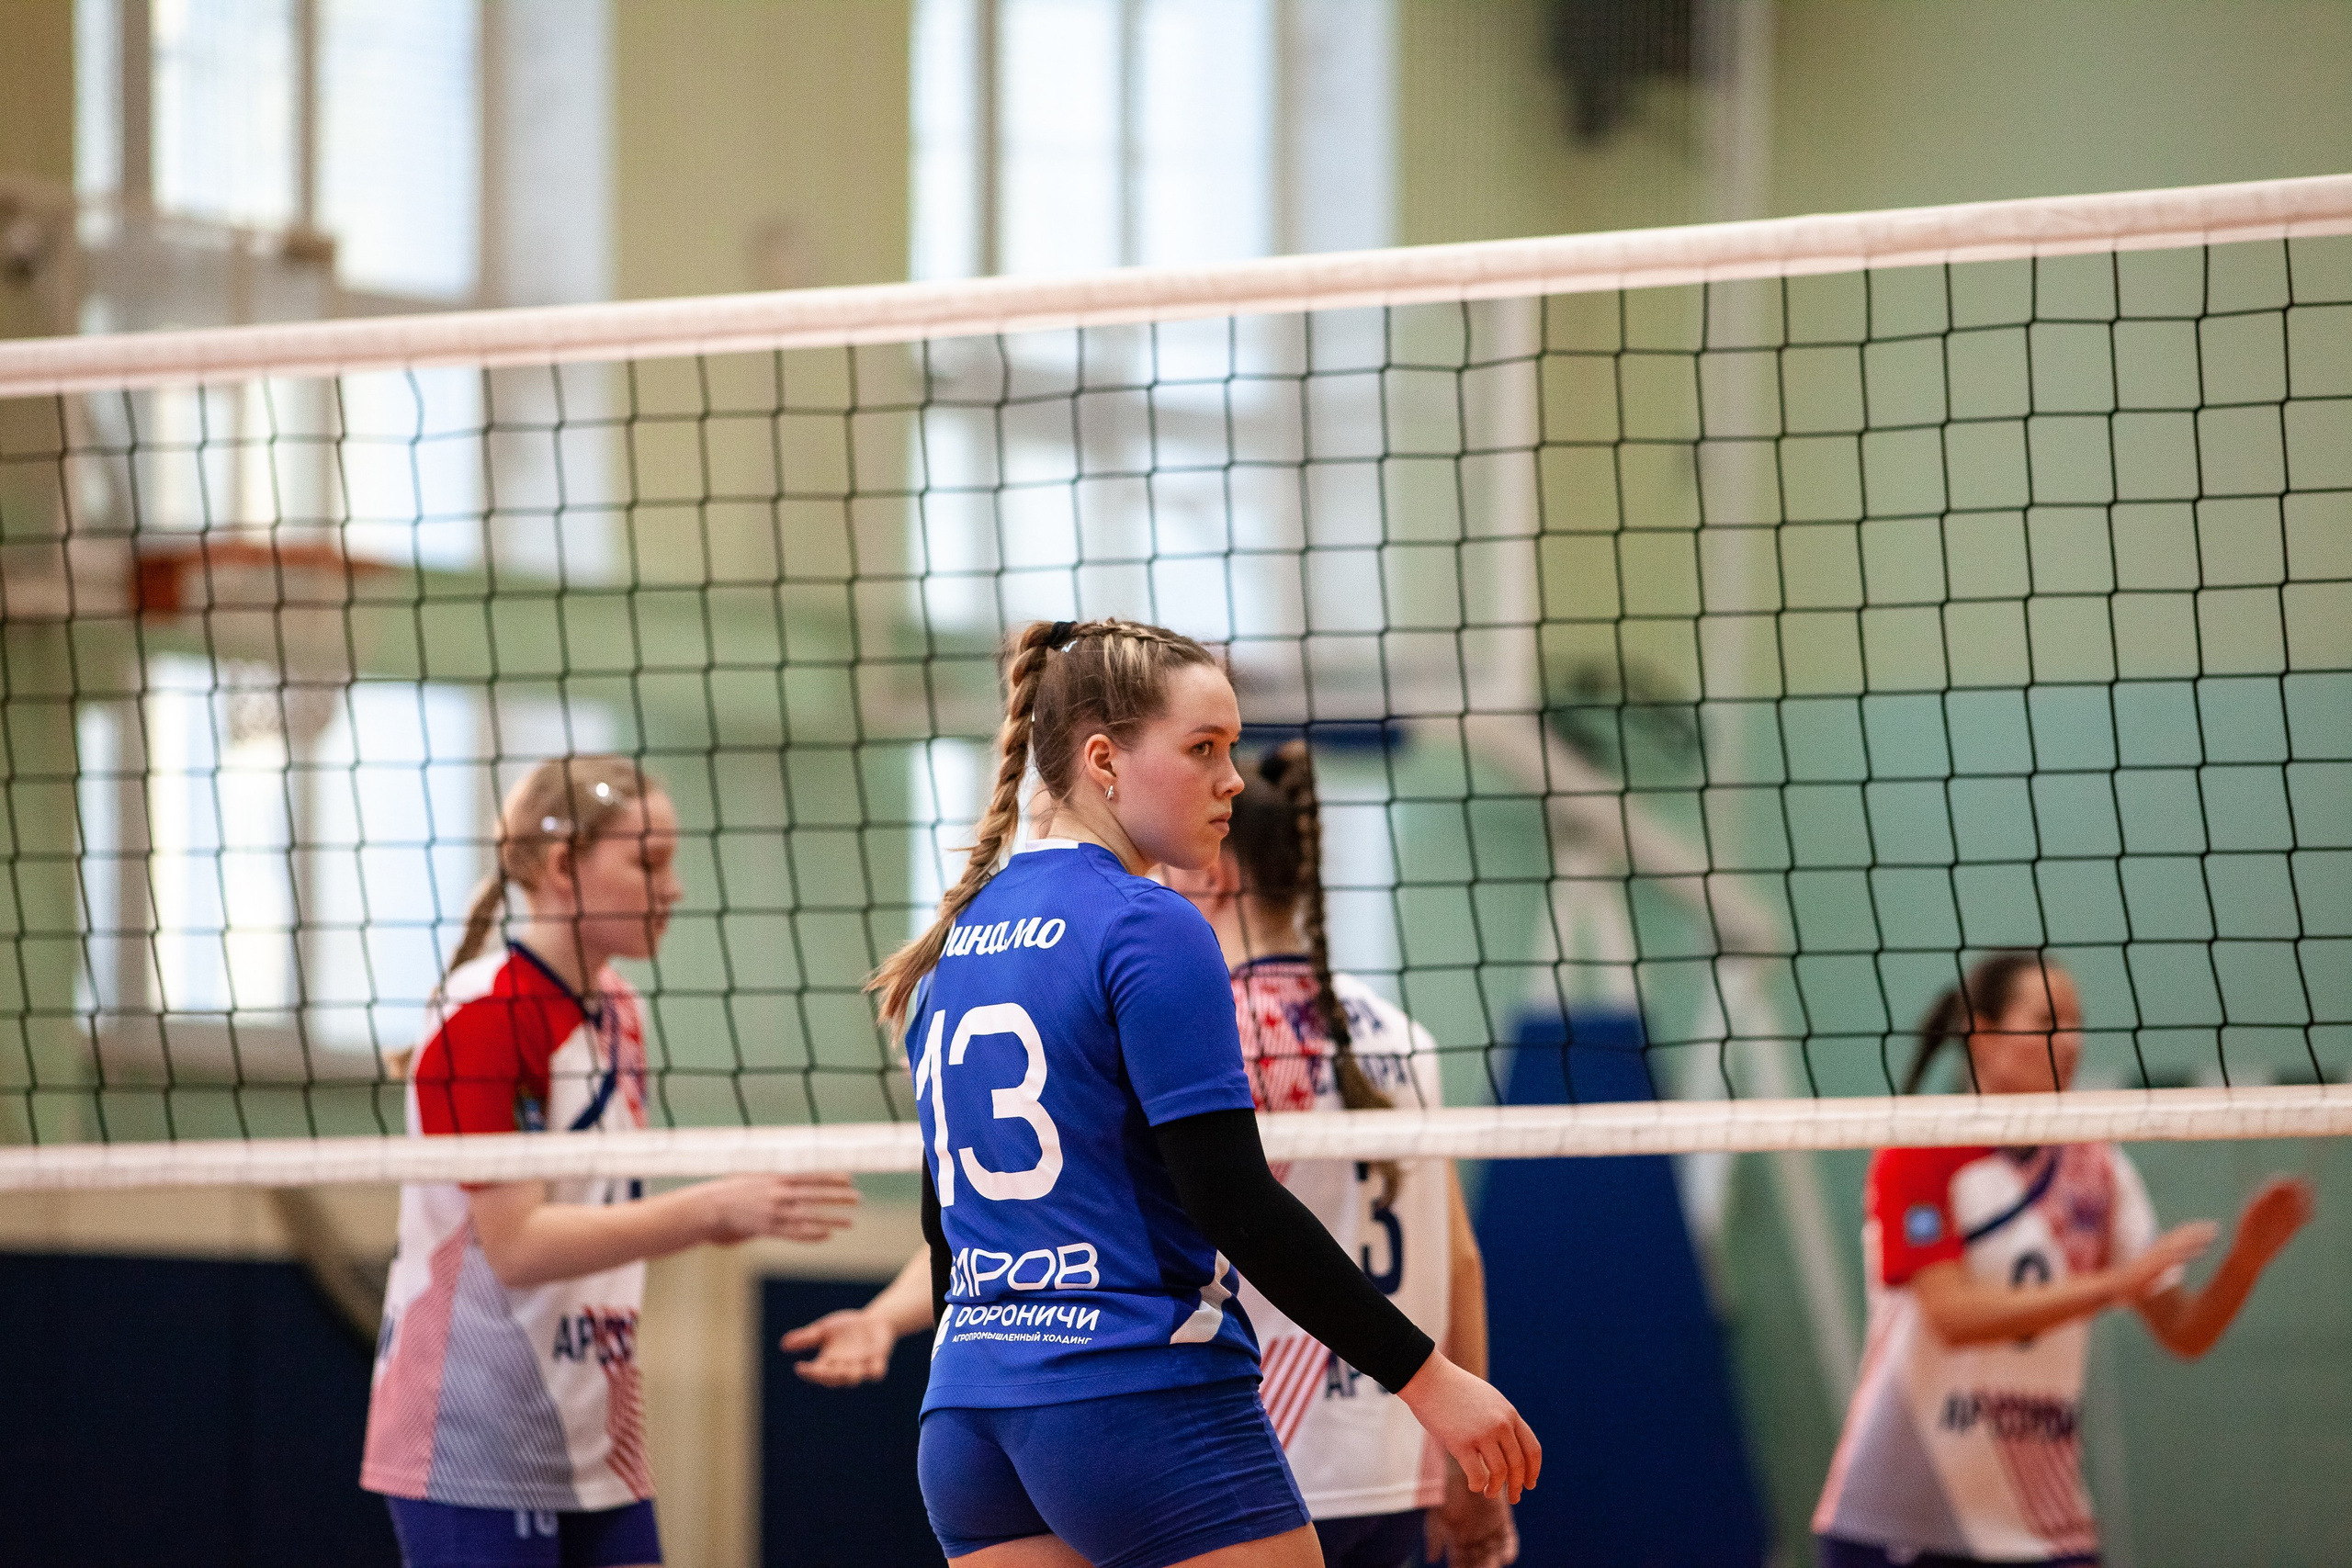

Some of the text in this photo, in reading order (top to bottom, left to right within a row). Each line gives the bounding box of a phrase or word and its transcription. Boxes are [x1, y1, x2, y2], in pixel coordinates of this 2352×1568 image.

[916, 1002, 1064, 1207] 13
[950, 1242, 1100, 1297] ИРОВ
[952, 1331, 1092, 1345] АГРОПРОМЫШЛЕННЫЙ ХОЛДИНГ
